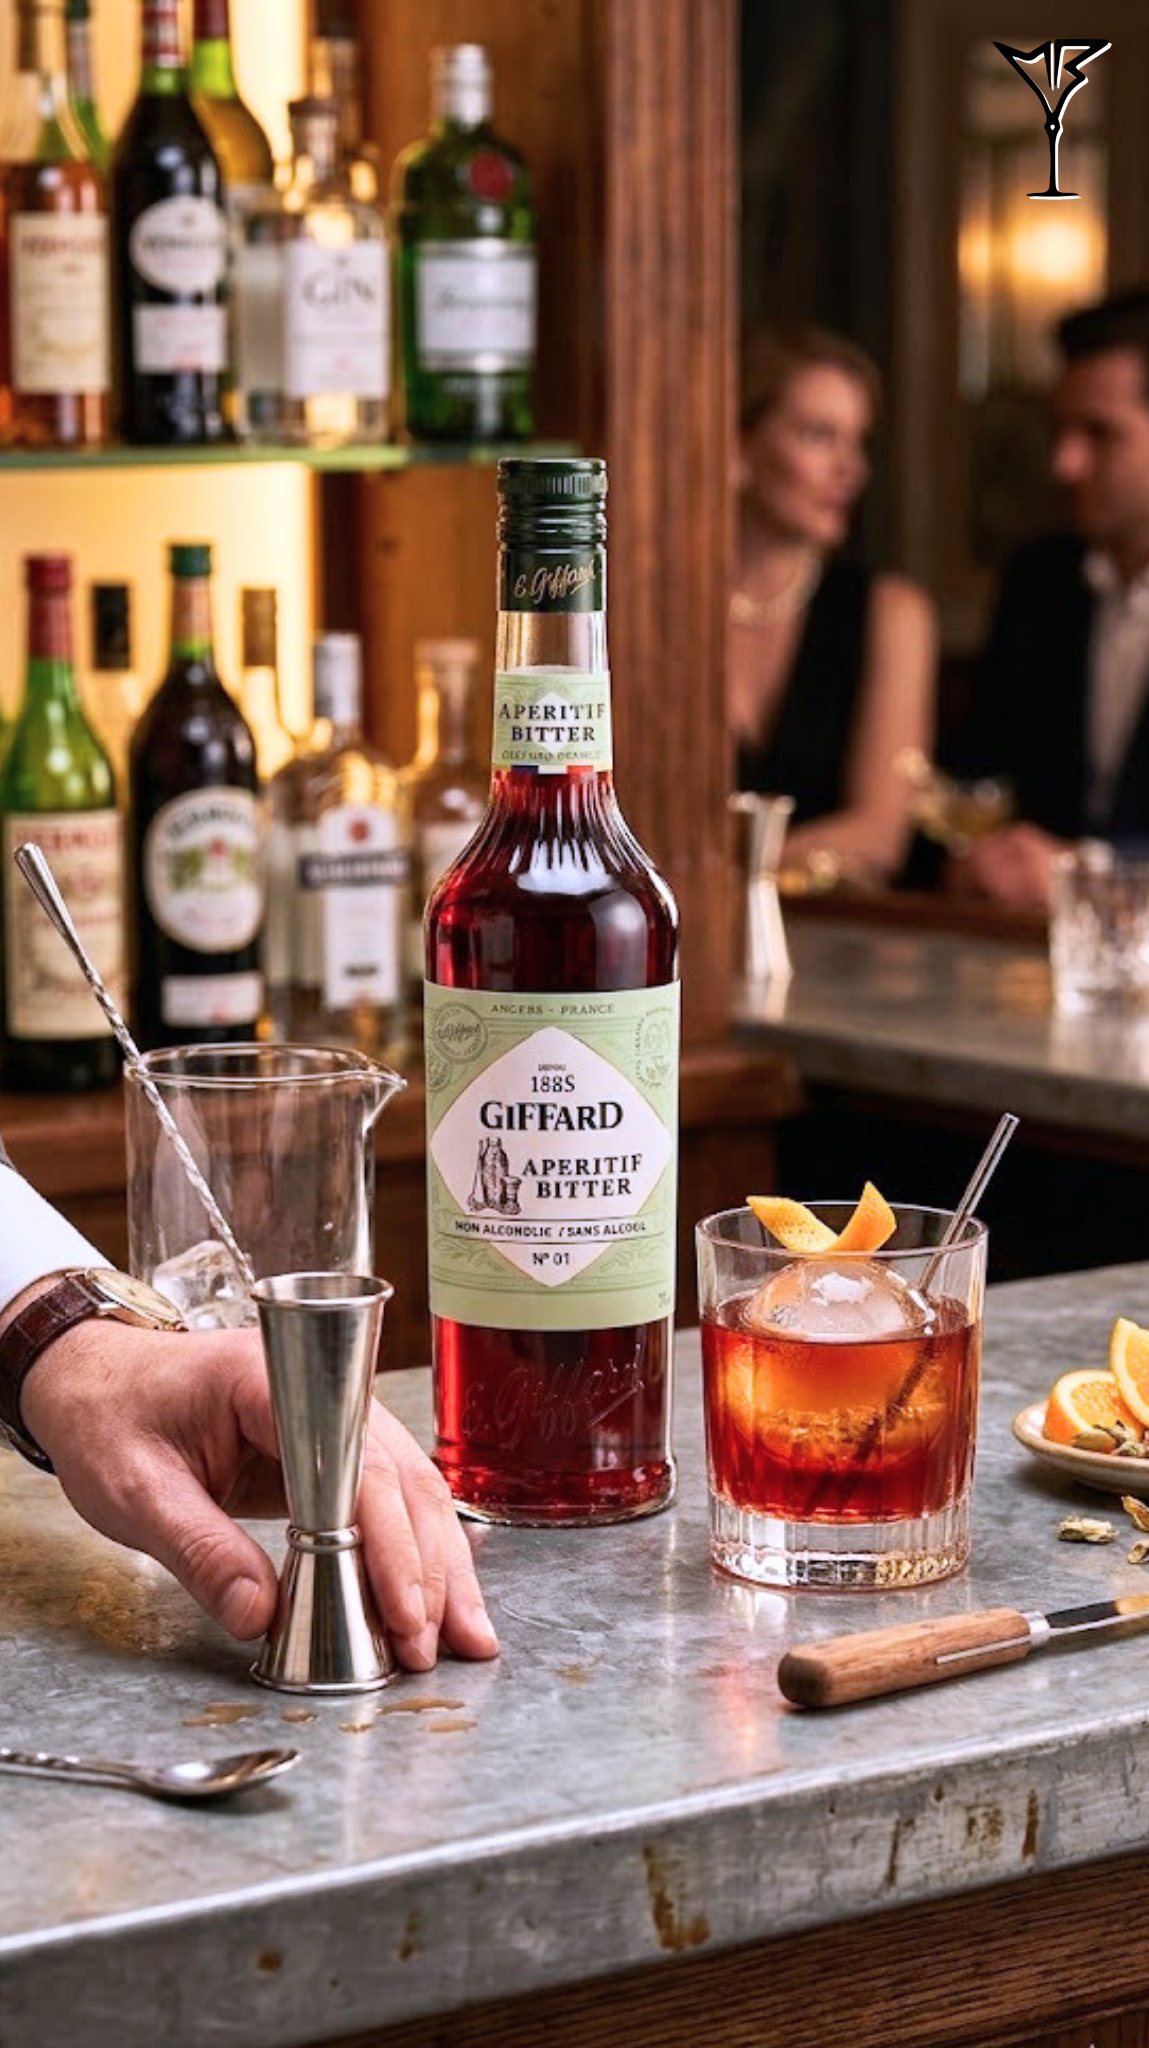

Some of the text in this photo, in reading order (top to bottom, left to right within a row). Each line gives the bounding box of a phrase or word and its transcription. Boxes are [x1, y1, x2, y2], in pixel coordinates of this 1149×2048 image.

[499, 703, 606, 720] APERITIF
[511, 726, 595, 742] BITTER
[480, 1100, 623, 1130] GIFFARD
[523, 1153, 643, 1176] APERITIF
[536, 1178, 632, 1198] BITTER
[567, 1225, 600, 1237] SANS
[553, 1252, 570, 1265] 01
